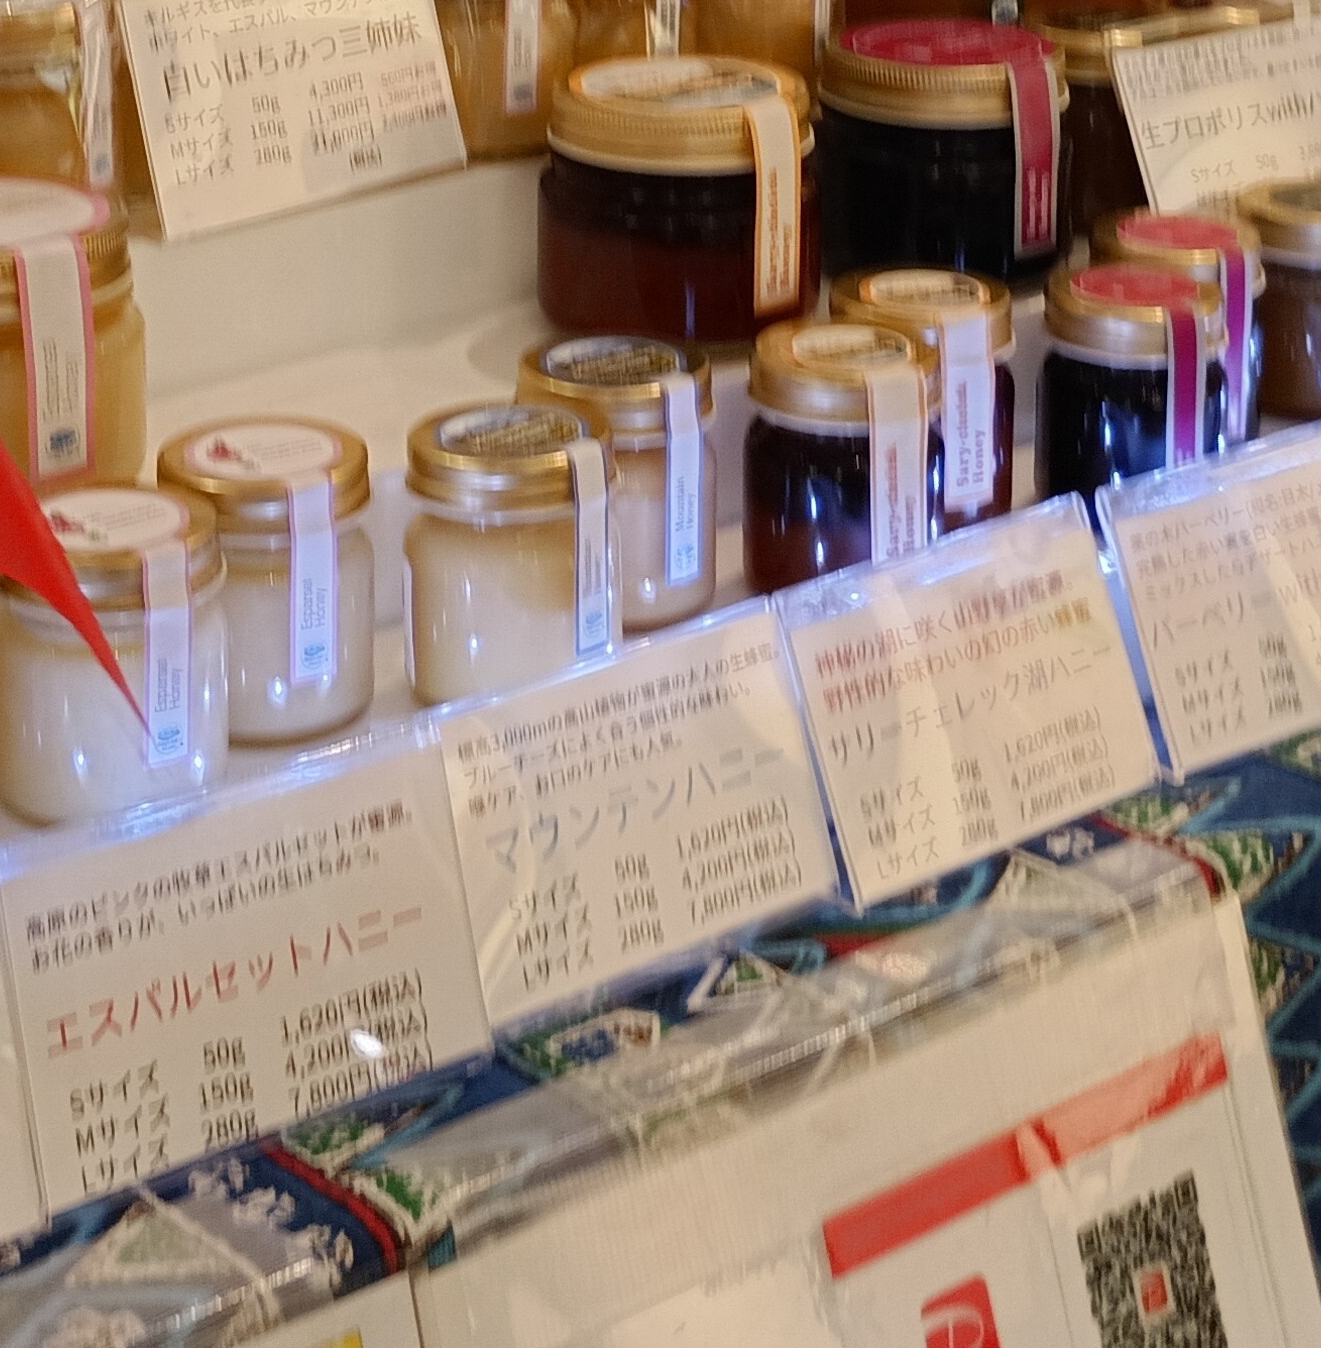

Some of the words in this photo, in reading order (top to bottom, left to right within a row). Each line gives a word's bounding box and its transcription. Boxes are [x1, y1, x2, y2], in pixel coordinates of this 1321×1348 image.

[162, 11, 423, 102] 白いはちみつ三姉妹
[165, 104, 225, 134] Sサイズ
[309, 72, 364, 99] 4,300円
[170, 128, 234, 160] Mサイズ
[308, 96, 371, 127] 11,300円
[176, 155, 235, 187] Lサイズ
[1190, 159, 1237, 184] Sサイズ
[1152, 590, 1273, 650] バーベリー
[1003, 705, 1102, 765] 1,620円(税込)
[484, 747, 786, 874] マウンテンハニー
[876, 836, 940, 880] Lサイズ
[46, 906, 423, 1060] エスパルセットハニー
[69, 1059, 160, 1121] Sサイズ
[75, 1092, 170, 1156] Mサイズ
[285, 1006, 428, 1084] 4,200税込)
[80, 1132, 170, 1195] Lサイズ
